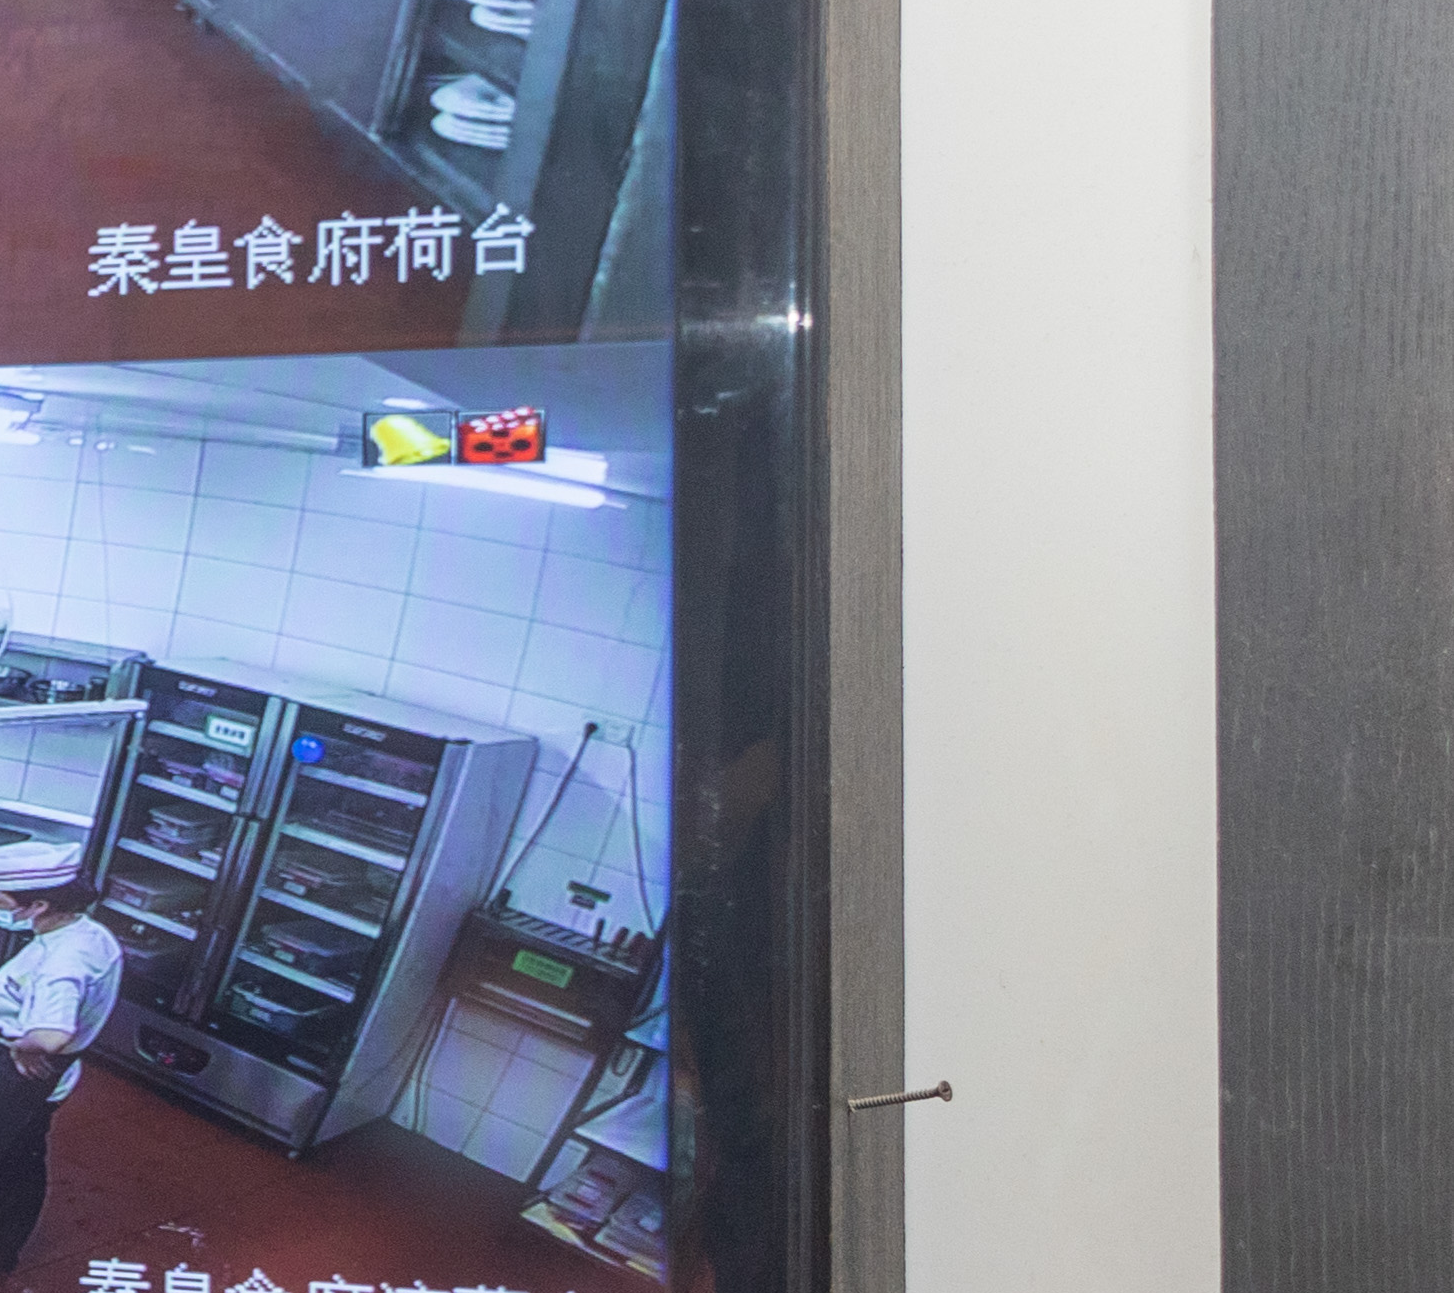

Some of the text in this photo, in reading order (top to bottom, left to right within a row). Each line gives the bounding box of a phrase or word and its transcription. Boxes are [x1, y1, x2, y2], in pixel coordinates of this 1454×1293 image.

[88, 202, 535, 297] 秦皇食府荷台
